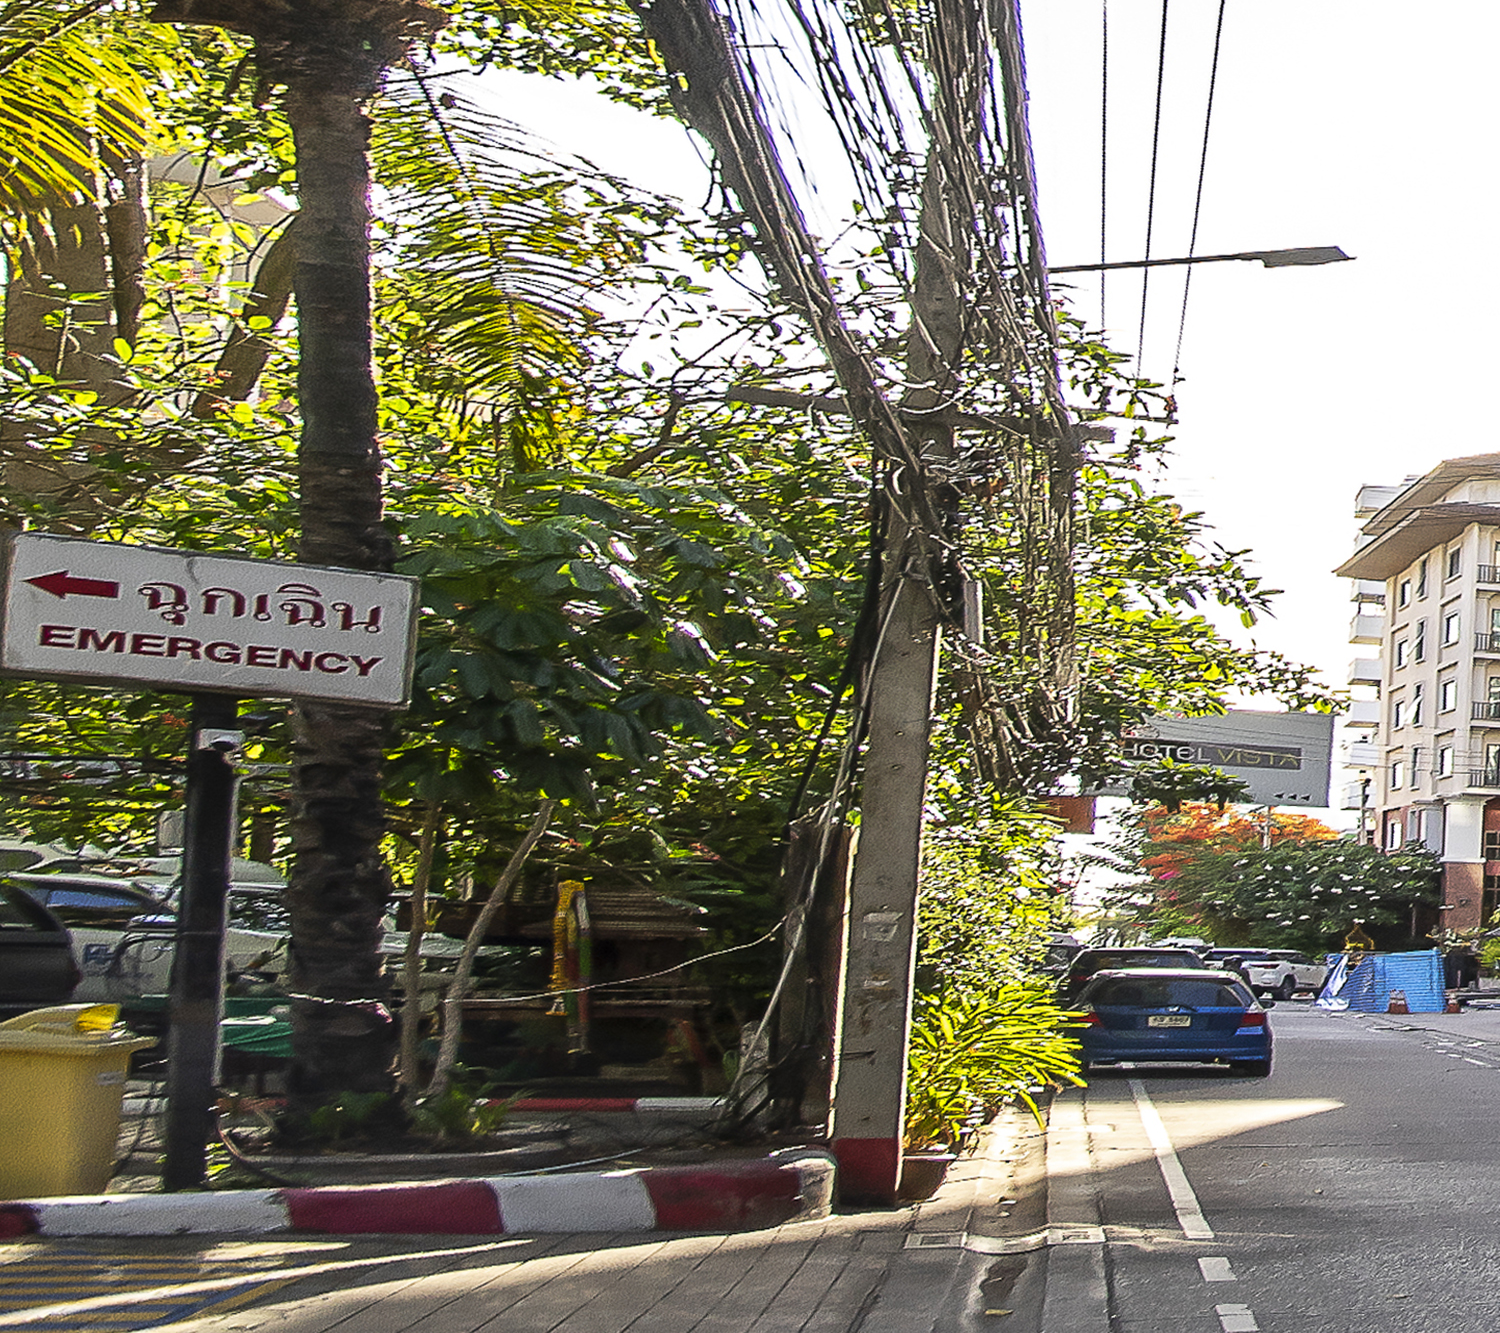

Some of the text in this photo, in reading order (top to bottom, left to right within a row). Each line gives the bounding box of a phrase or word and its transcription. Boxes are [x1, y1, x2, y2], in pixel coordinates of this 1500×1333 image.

[138, 582, 382, 634] ฉุกเฉิน
[38, 624, 383, 677] EMERGENCY
[1120, 741, 1299, 767] HOTEL VISTA
